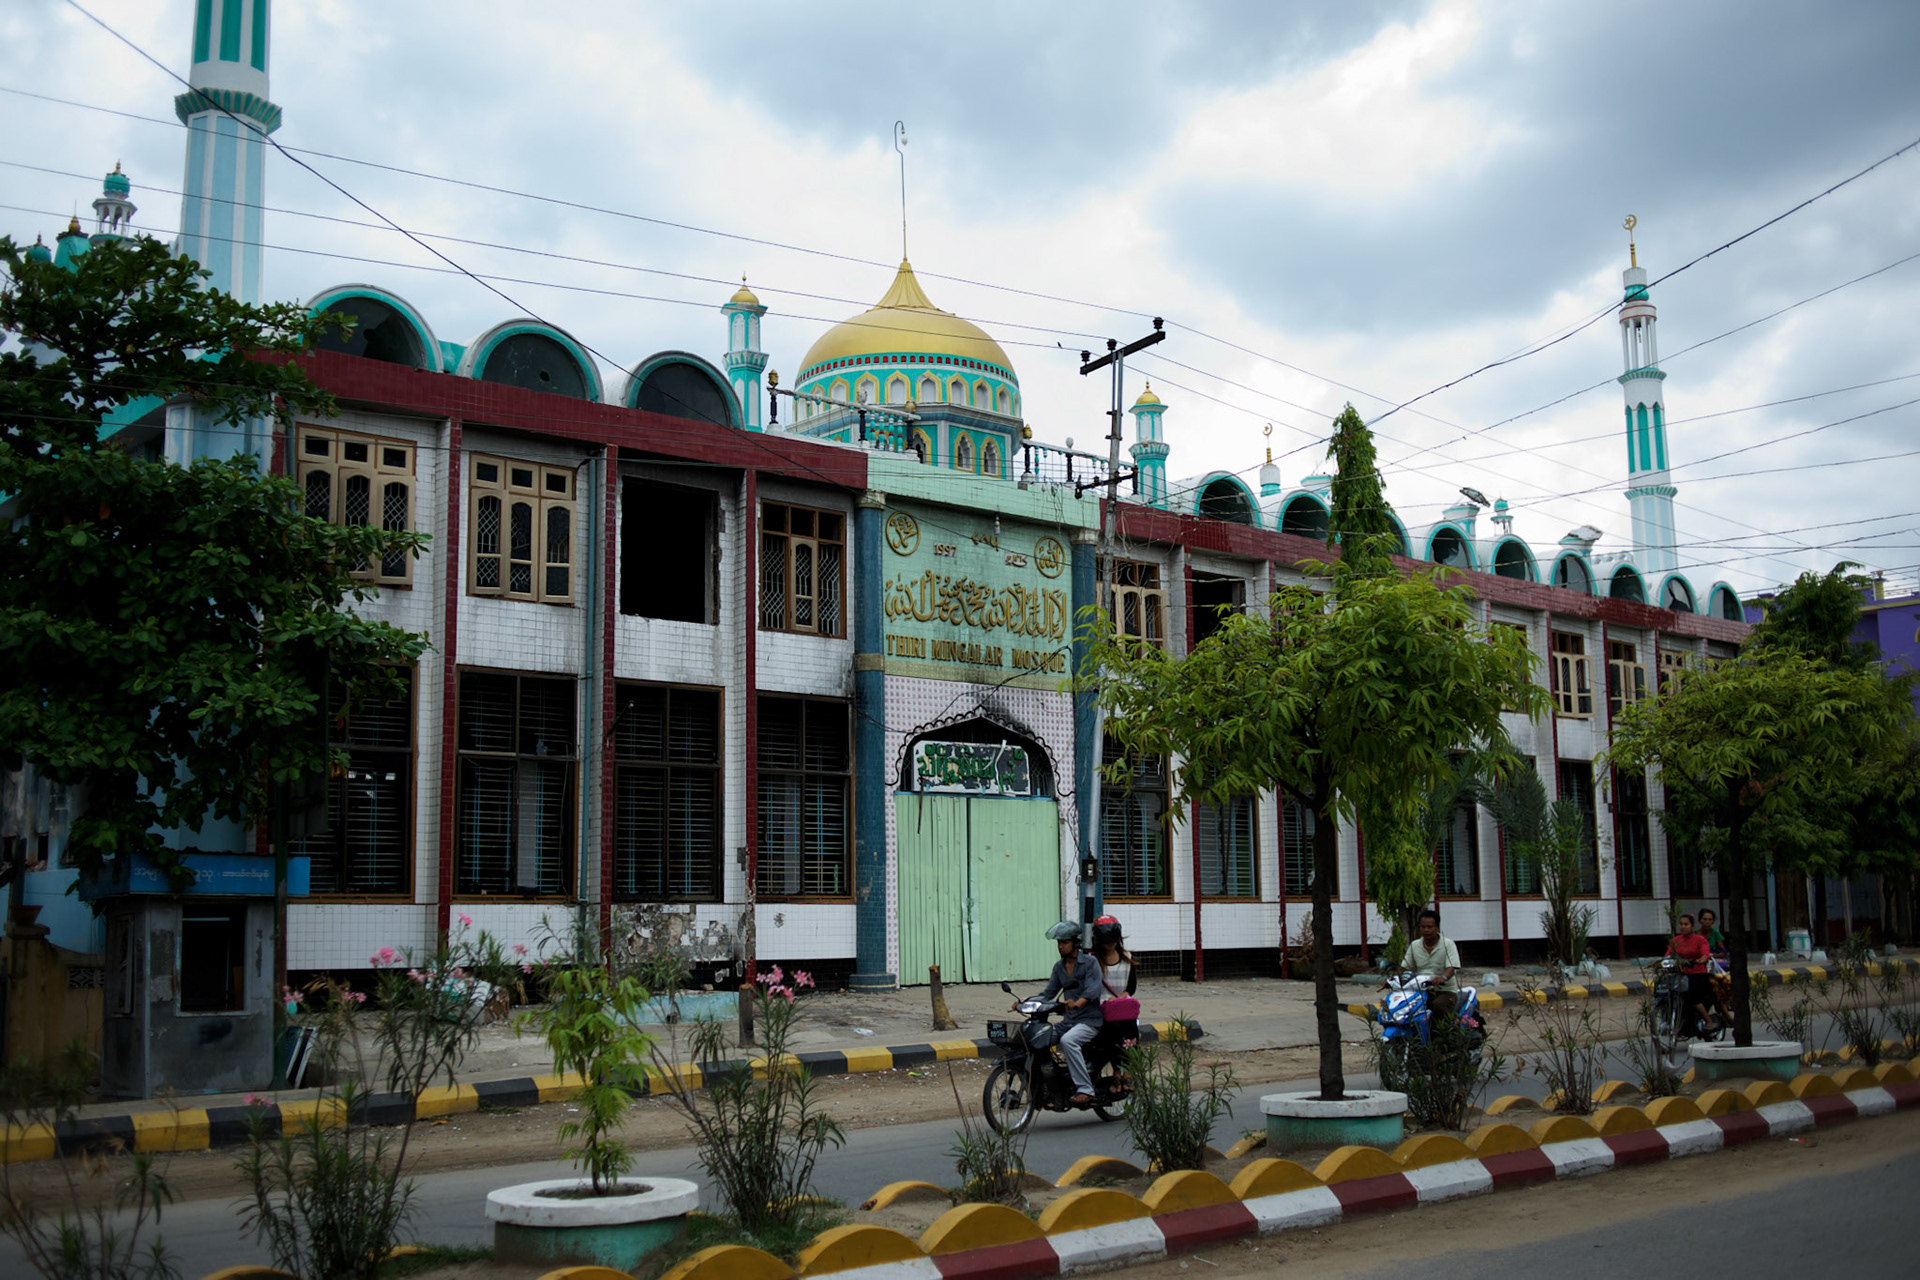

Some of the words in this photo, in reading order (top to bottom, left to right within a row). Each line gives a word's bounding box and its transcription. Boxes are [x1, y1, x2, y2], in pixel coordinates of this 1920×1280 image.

[934, 543, 957, 557] 1997
[886, 634, 926, 659] THIRI
[931, 639, 1003, 667] MINGALAR
[1012, 648, 1067, 674] MOSQUE
